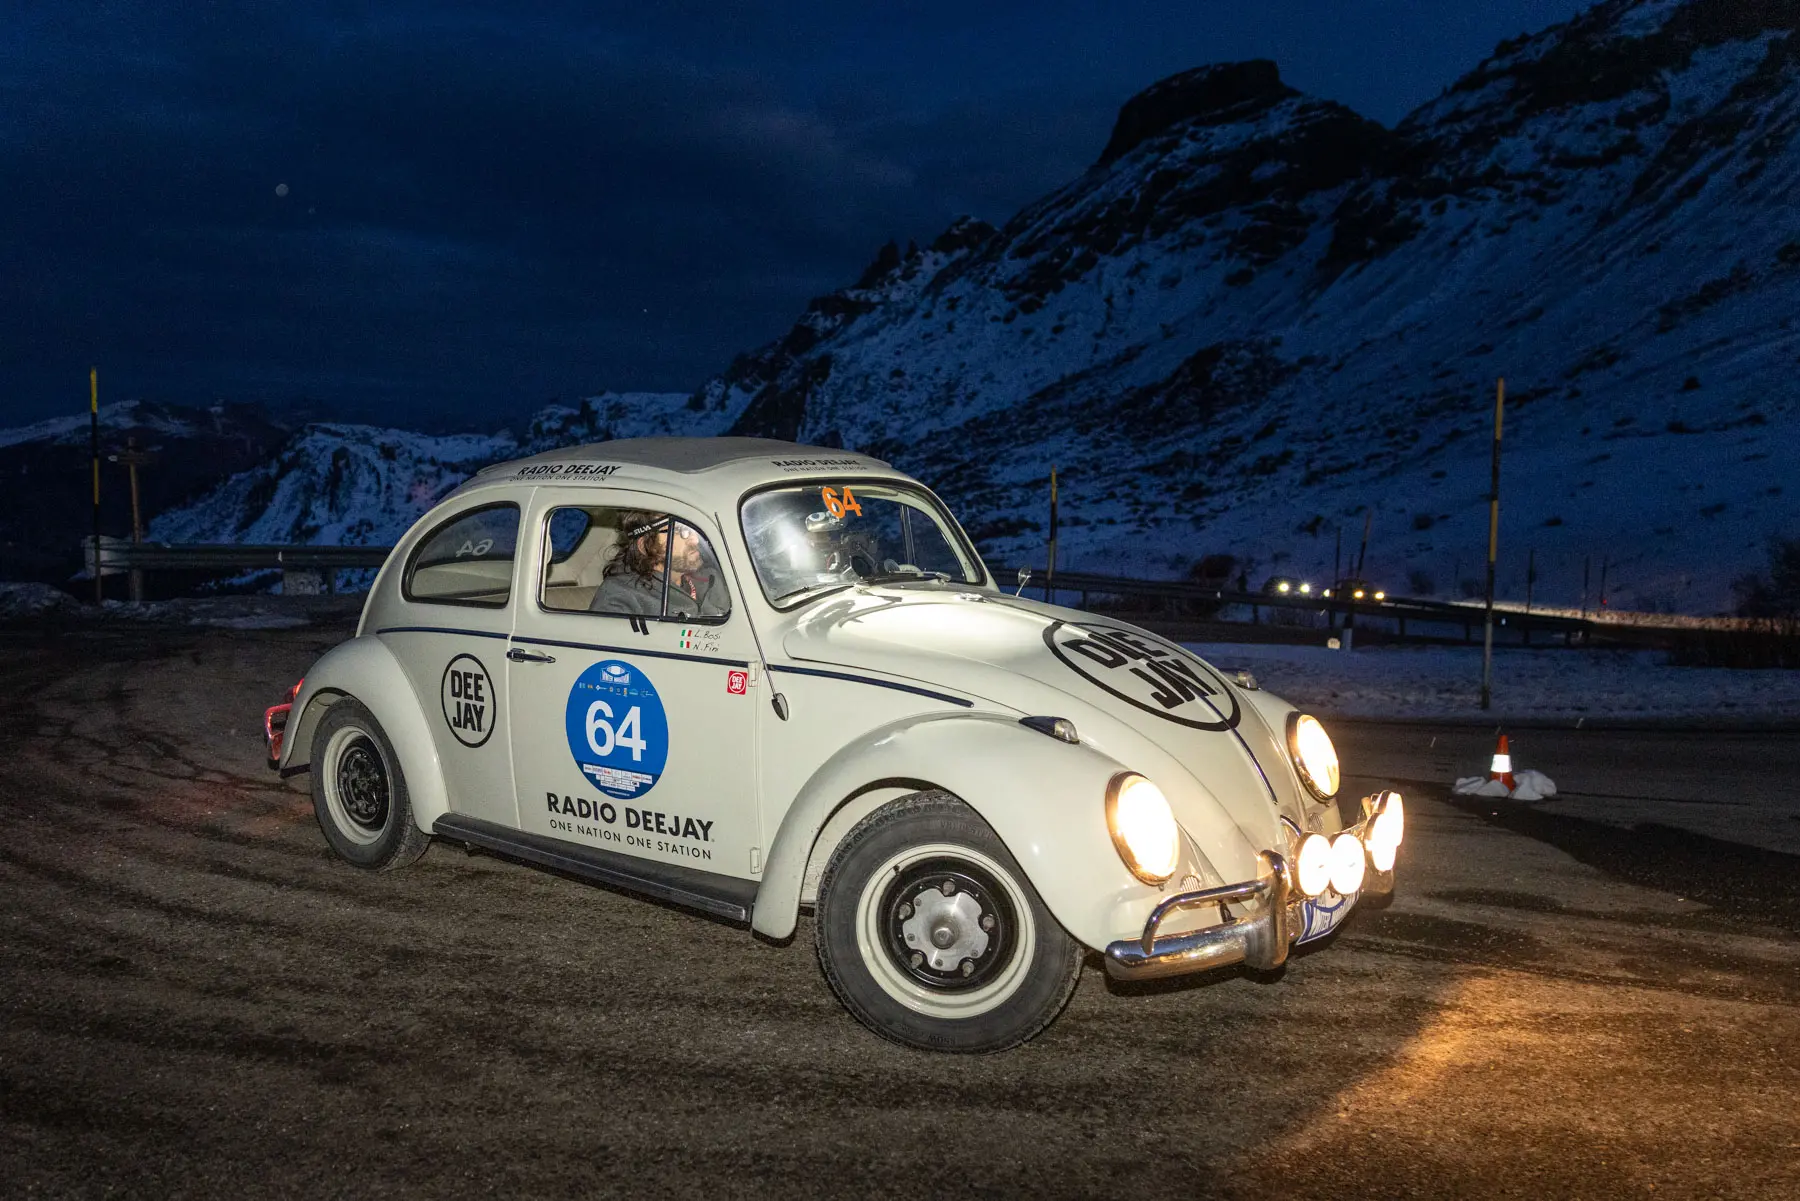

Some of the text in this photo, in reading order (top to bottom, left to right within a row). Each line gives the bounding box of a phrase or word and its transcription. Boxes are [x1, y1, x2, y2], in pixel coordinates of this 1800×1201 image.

[518, 464, 621, 476] RADIO DEEJAY
[822, 486, 862, 519] 64
[633, 524, 652, 536] SILVA
[1061, 631, 1170, 669] DEE
[450, 669, 485, 703] DEE
[732, 675, 743, 683] DEE
[732, 682, 743, 690] JAY
[1129, 658, 1218, 710] JAY
[452, 700, 485, 733] JAY
[585, 699, 647, 762] 64
[546, 791, 714, 842] RADIO DEEJAY
[550, 818, 712, 861] ONE NATION ONE STATION
